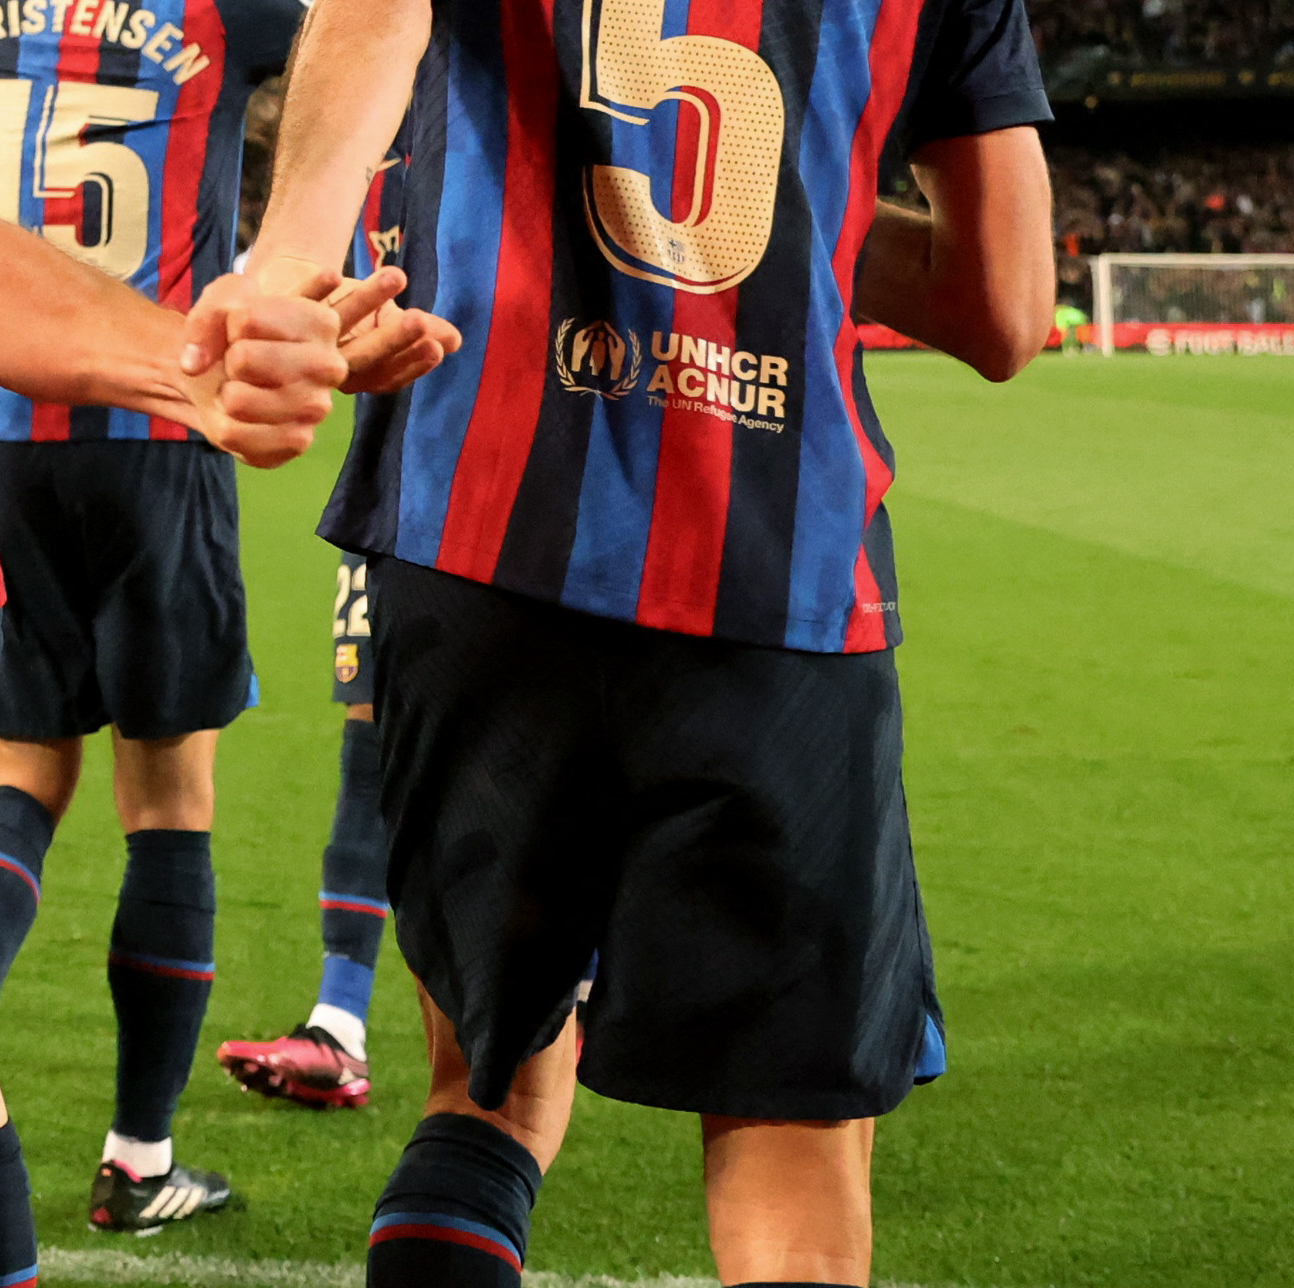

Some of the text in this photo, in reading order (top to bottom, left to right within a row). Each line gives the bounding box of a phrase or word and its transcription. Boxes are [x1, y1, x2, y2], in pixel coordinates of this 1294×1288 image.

[651, 331, 789, 387] UNHCR
[646, 364, 786, 418] ACNUR
[648, 395, 785, 434] The UN Refugee Agency
